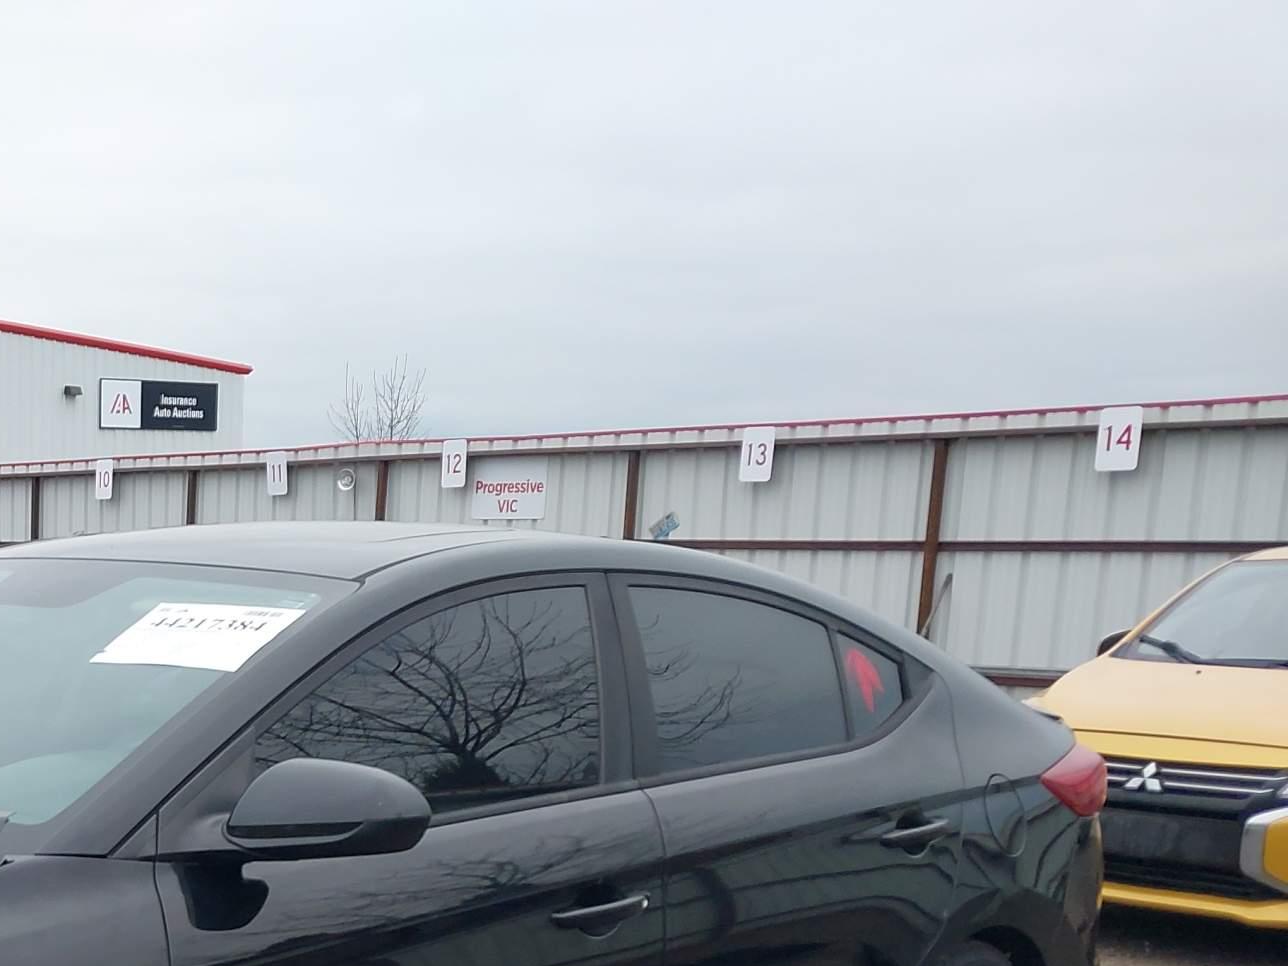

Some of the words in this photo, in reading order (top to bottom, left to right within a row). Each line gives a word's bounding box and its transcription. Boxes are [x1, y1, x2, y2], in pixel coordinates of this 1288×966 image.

[154, 407, 171, 418] Auto
[172, 407, 204, 419] Auctions
[1105, 424, 1133, 452] 14
[747, 443, 768, 466] 13
[446, 454, 462, 474] 12
[98, 471, 110, 488] 10
[270, 464, 282, 483] 11
[475, 479, 544, 496] Progressive
[498, 500, 518, 513] VIC
[150, 617, 268, 632] 44217384
